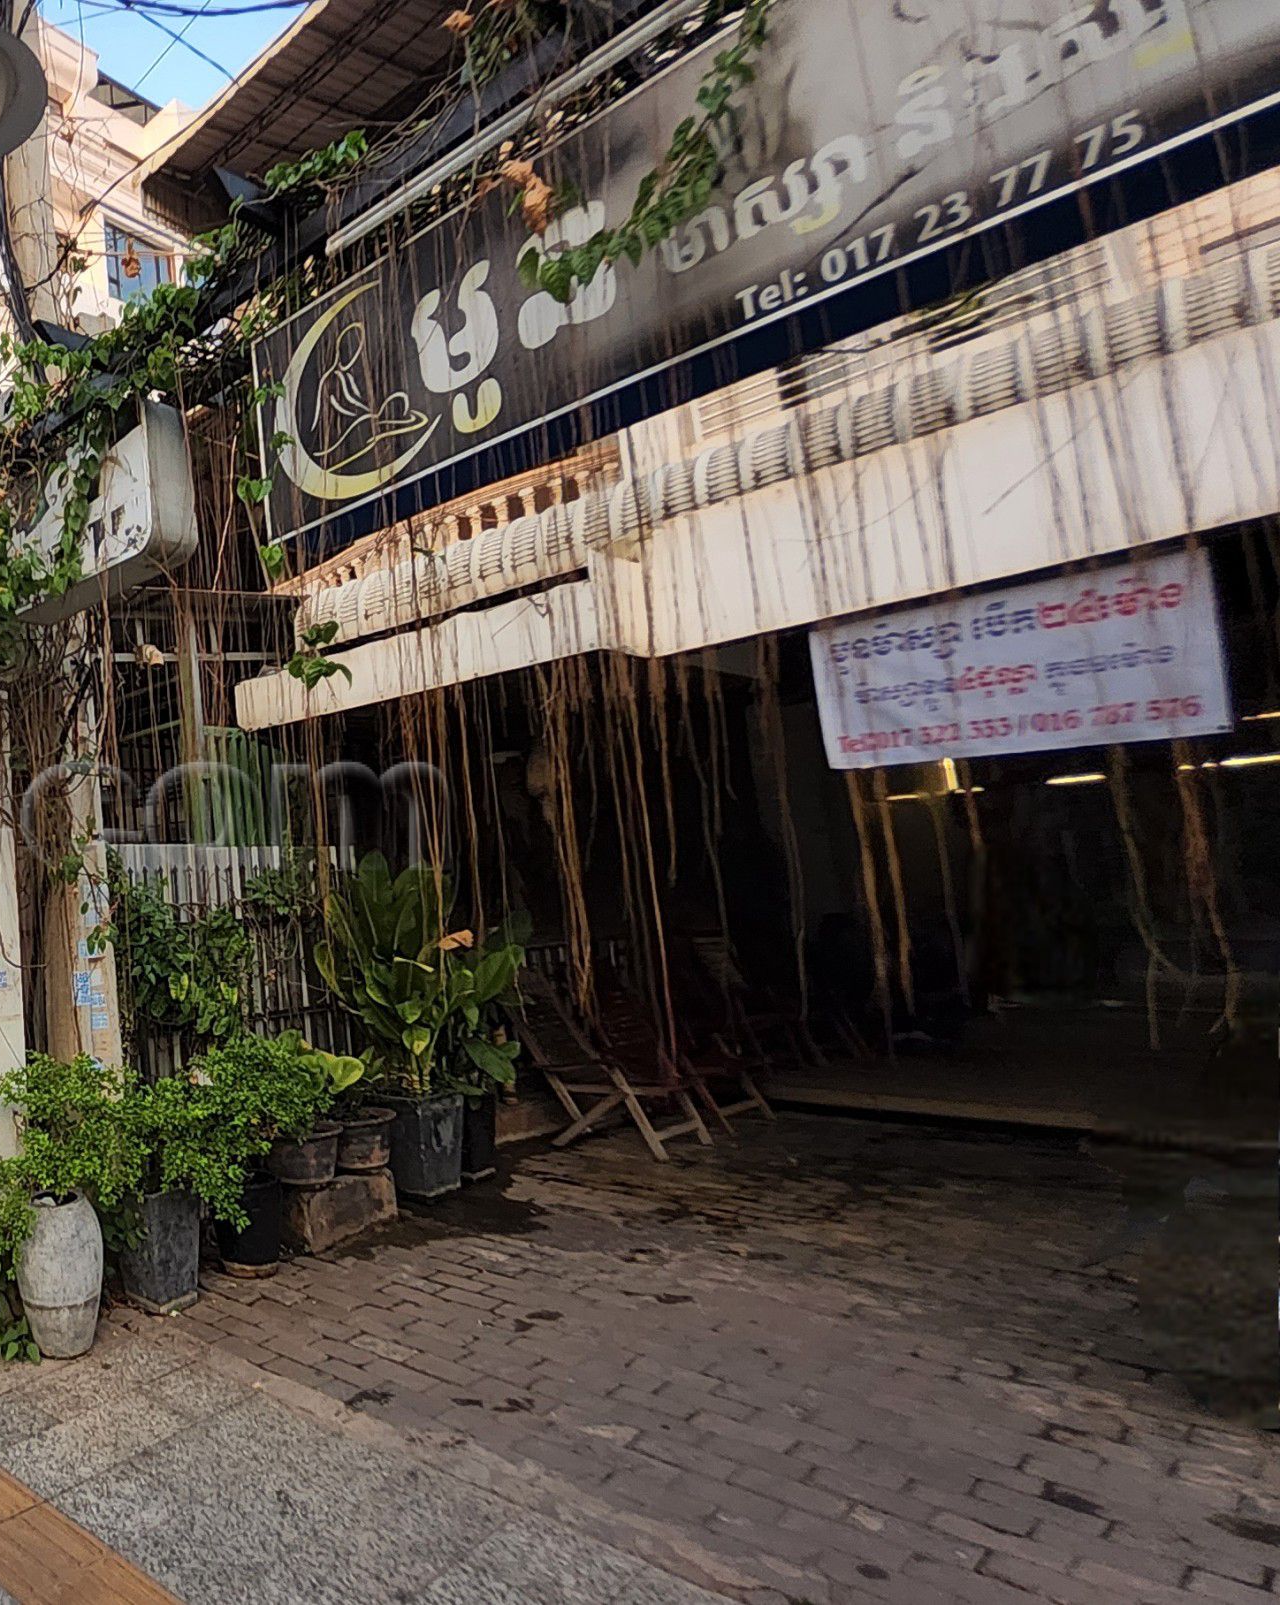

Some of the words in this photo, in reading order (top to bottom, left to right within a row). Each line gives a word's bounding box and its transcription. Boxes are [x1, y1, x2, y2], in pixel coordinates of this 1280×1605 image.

[735, 269, 809, 320] Tel:
[820, 223, 898, 283] 017
[914, 191, 972, 244] 23
[989, 149, 1054, 209] 77
[1073, 109, 1147, 170] 75
